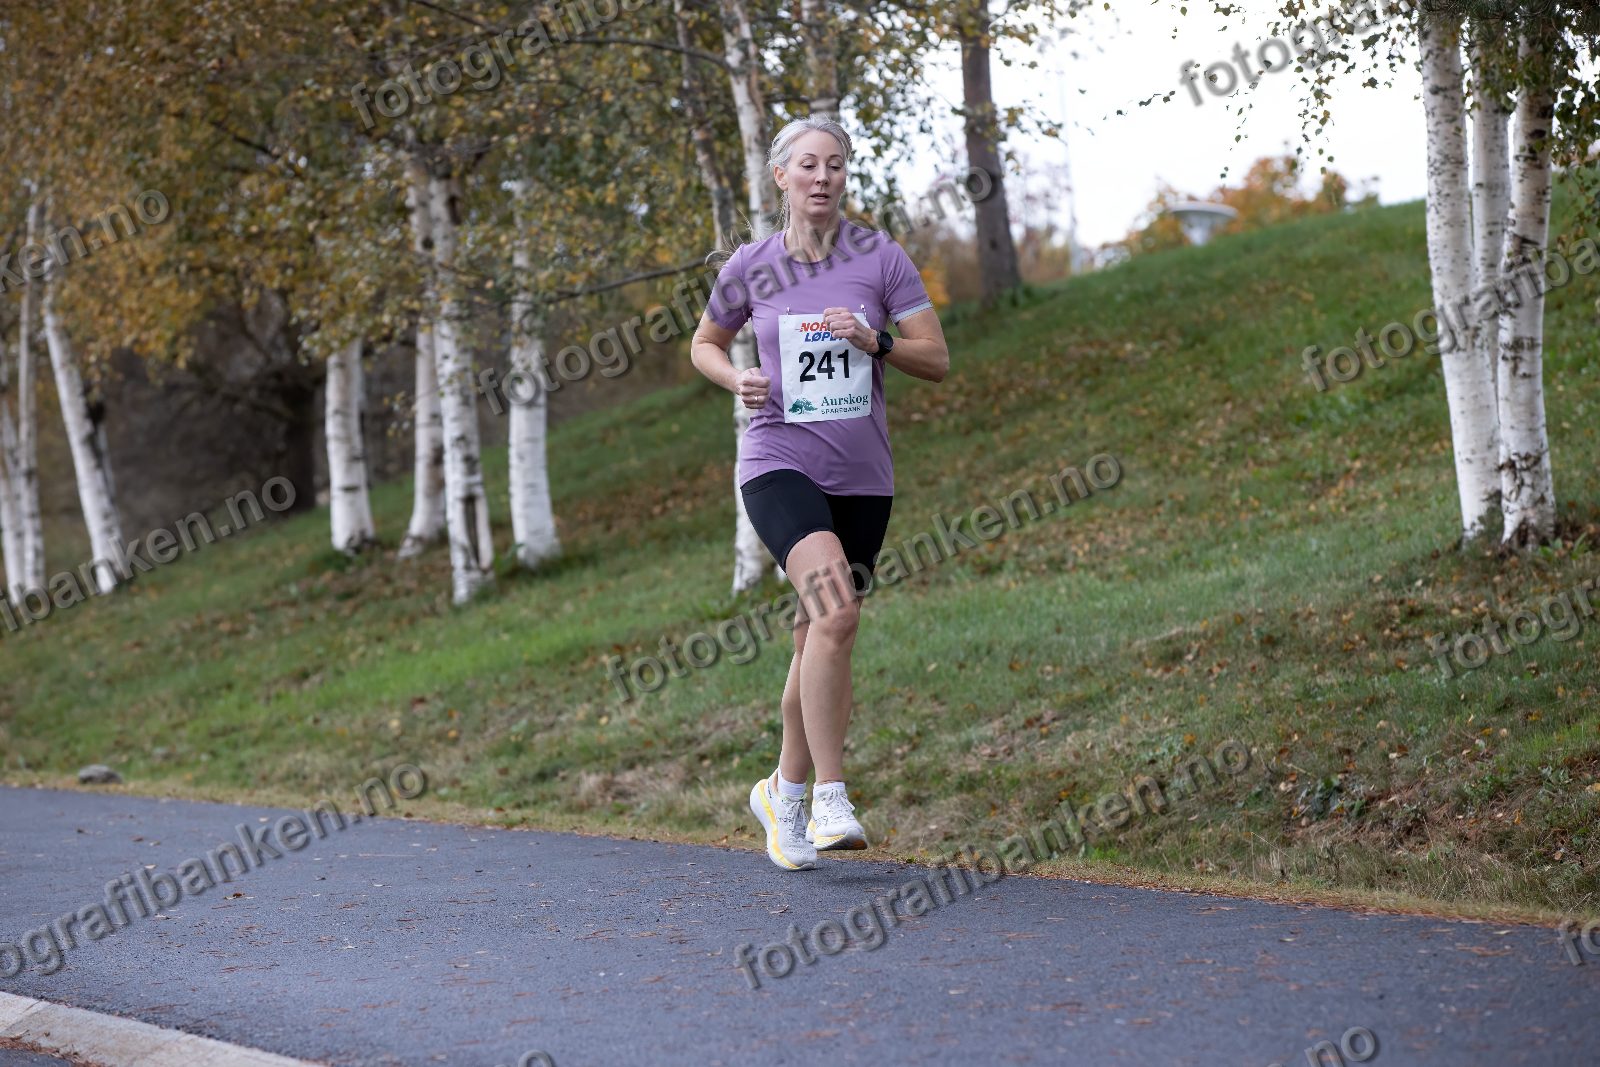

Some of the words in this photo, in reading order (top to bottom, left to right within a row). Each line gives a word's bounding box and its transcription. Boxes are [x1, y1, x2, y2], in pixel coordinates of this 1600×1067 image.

[800, 321, 828, 332] NOR
[804, 331, 843, 342] LØP
[798, 349, 850, 383] 241
[821, 393, 869, 406] Aurskog
[821, 406, 861, 415] SPAREBANK
